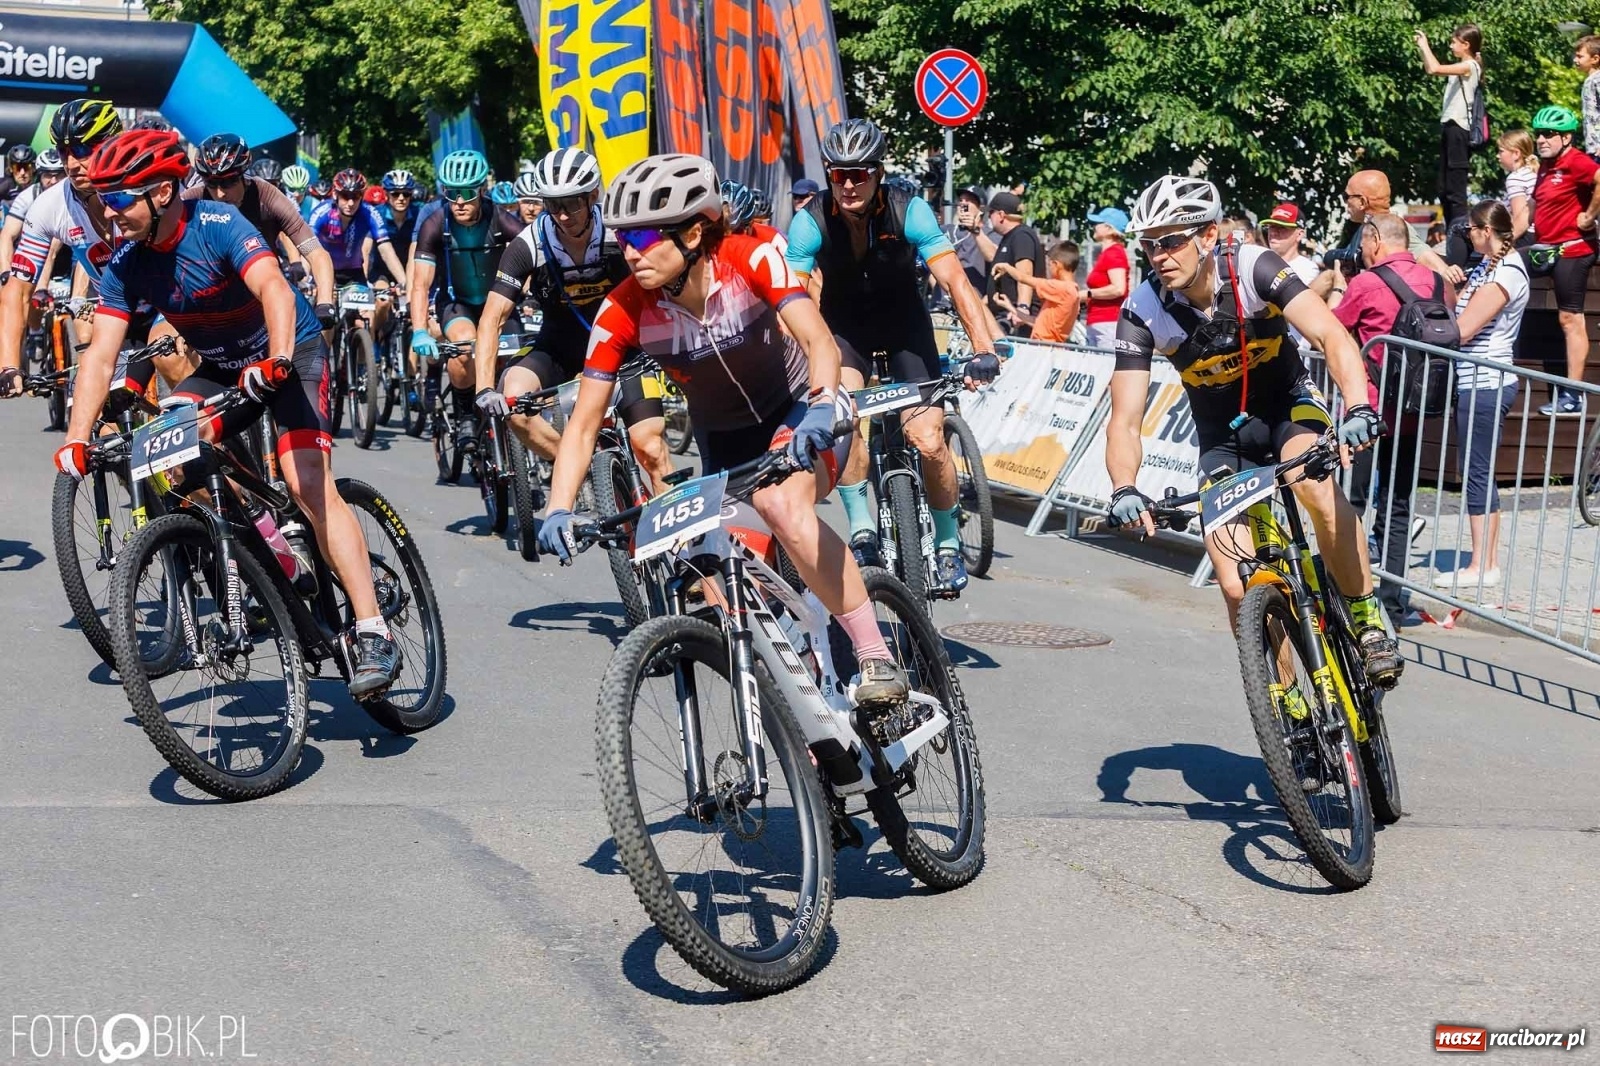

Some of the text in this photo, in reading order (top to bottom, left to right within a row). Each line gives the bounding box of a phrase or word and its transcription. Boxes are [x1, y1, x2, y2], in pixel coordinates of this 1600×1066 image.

[218, 349, 265, 370] ROMET
[865, 388, 909, 404] 2086
[1049, 413, 1078, 431] Taurus
[143, 427, 184, 456] 1370
[1214, 477, 1260, 511] 1580
[373, 497, 407, 537] MAXXIS
[652, 496, 705, 533] 1453
[880, 508, 892, 528] 32
